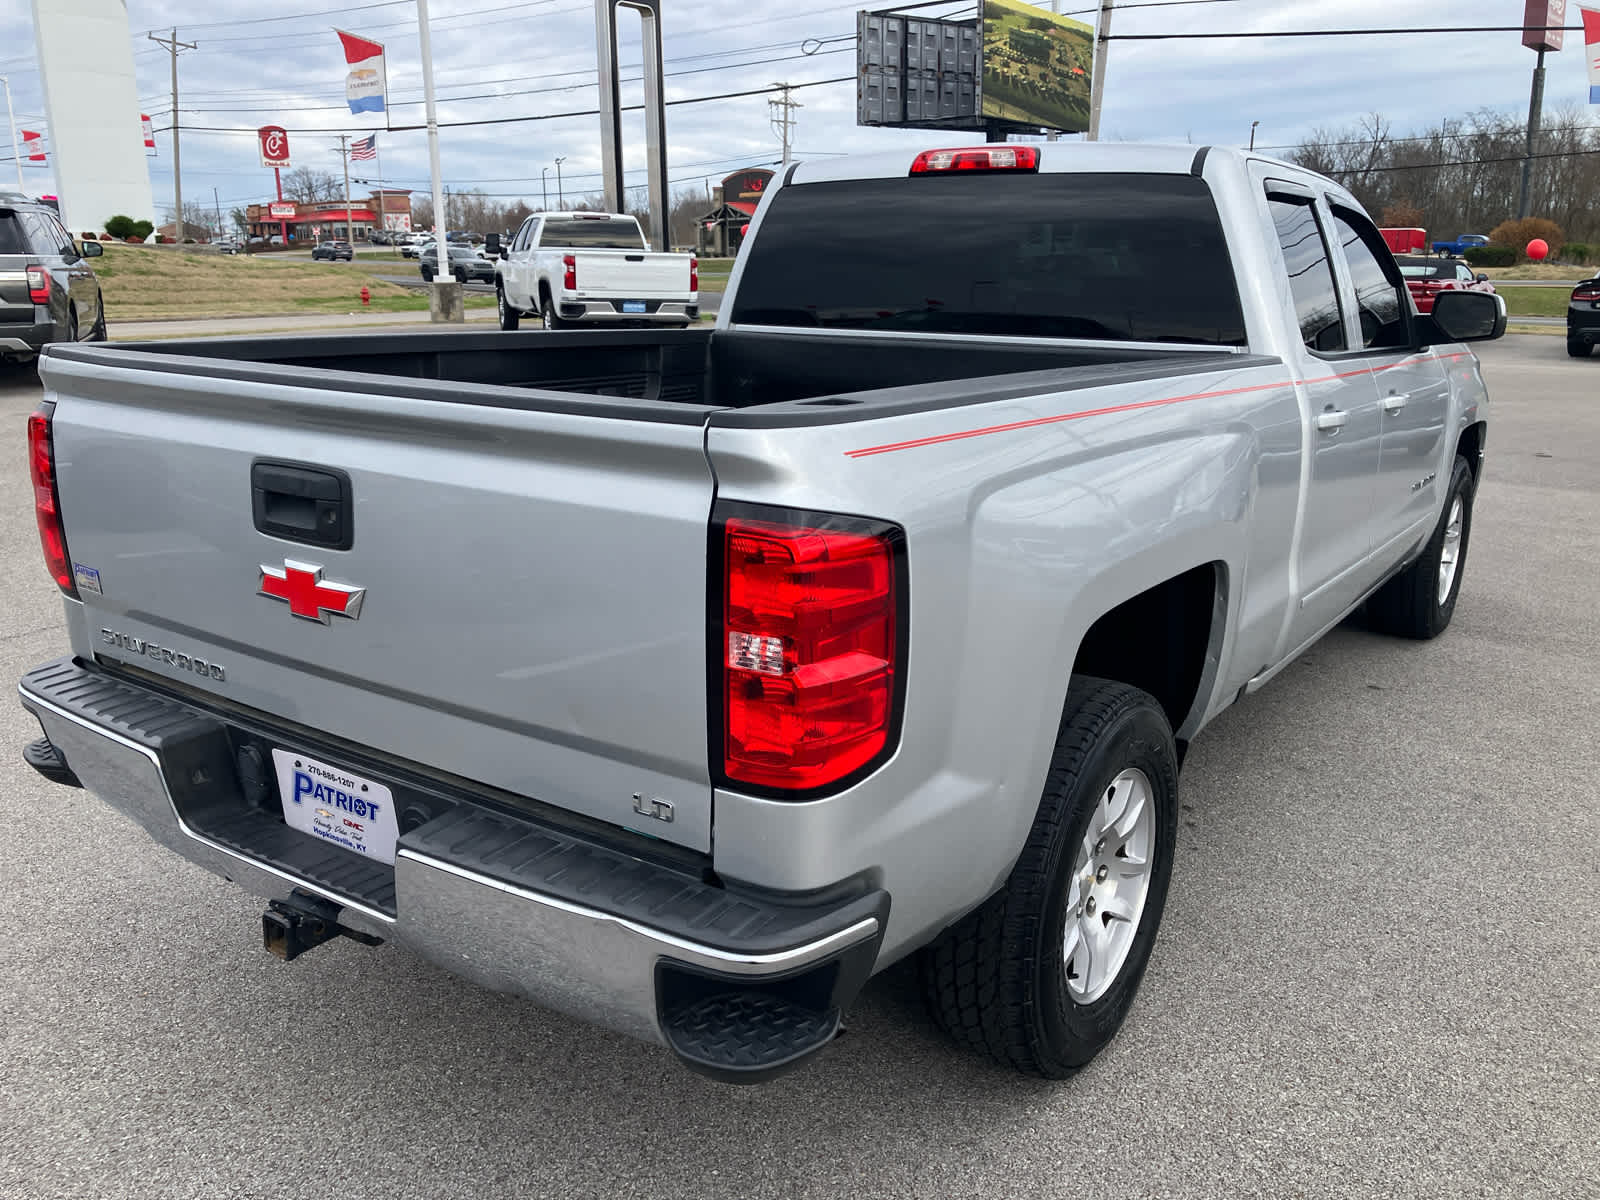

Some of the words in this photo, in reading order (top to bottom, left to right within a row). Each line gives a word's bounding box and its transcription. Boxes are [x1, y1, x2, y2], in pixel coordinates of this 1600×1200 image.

[101, 627, 225, 681] SILVERADO
[294, 770, 379, 821] PATRIOT
[307, 764, 355, 789] 270-886-1207
[343, 818, 364, 833] GMC
